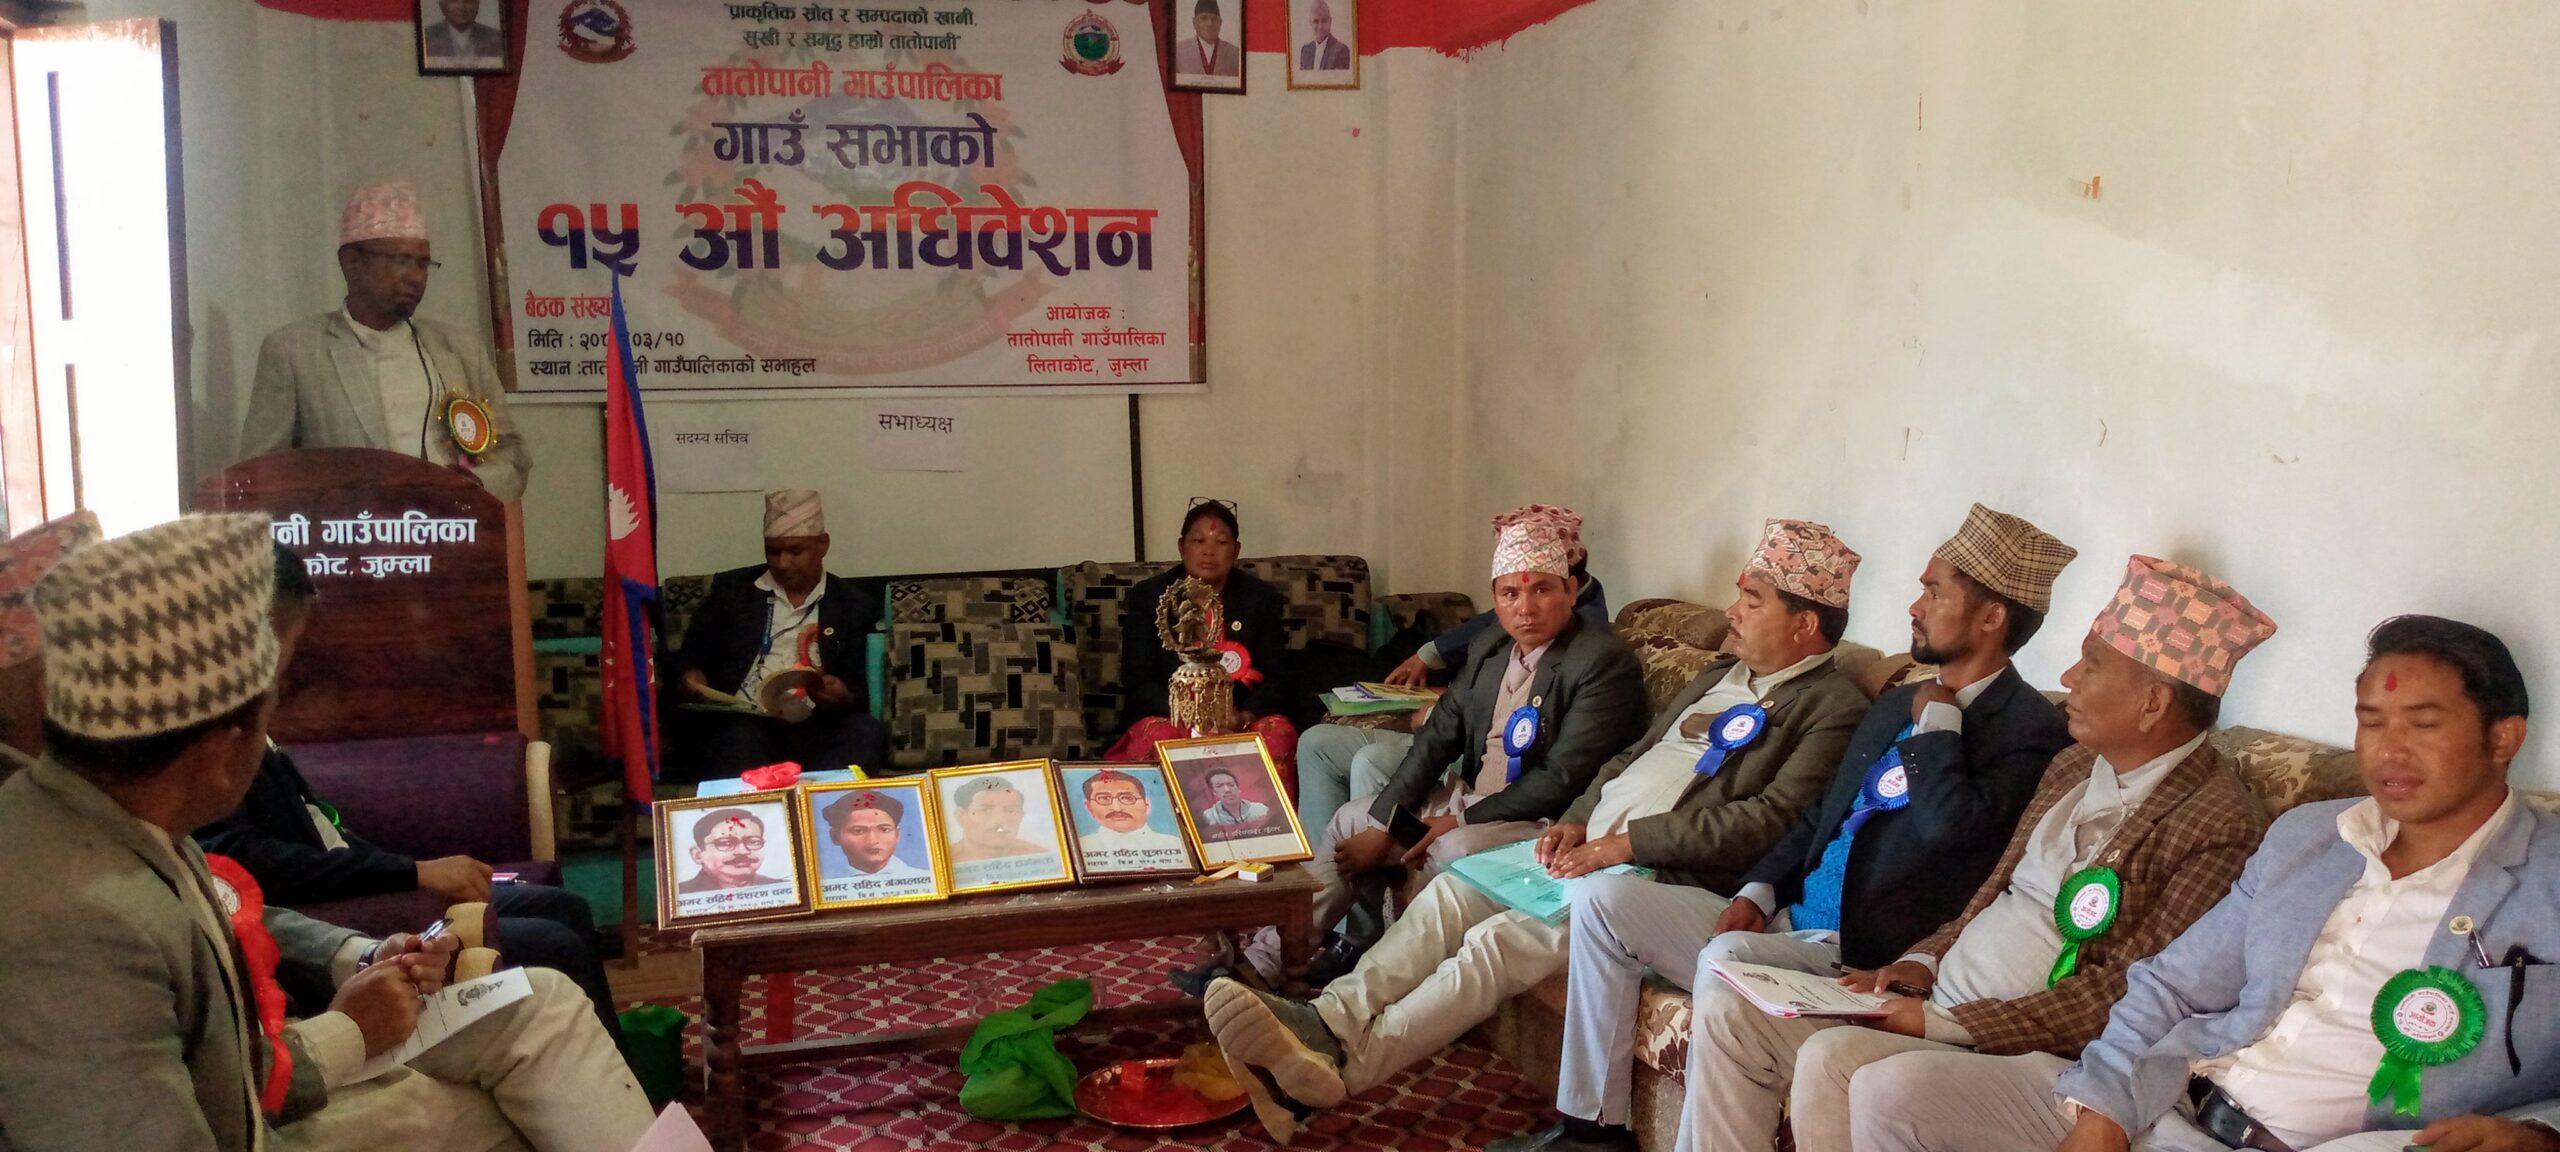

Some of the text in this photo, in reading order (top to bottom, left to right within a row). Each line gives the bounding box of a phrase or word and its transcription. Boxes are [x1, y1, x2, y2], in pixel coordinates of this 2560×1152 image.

[803, 4, 833, 22] स्रोत
[840, 8, 850, 22] र
[856, 6, 929, 25] सम्पदाको
[743, 27, 780, 49] सुखी
[786, 31, 797, 47] र
[848, 30, 884, 49] हाम्रो
[701, 58, 1003, 101] तातोपानी गाउँपालिका
[712, 108, 998, 169] गाउँ सभाको
[537, 178, 1158, 277] १५ औं अधिवेशन
[525, 289, 565, 318] बैठक
[571, 292, 613, 319] संख्य
[1047, 303, 1112, 321] आयोजक
[528, 328, 564, 349] मिति
[1007, 328, 1074, 347] तातोपानी
[1081, 326, 1167, 347] गाउँपालिका
[530, 359, 571, 377] स्थान
[654, 354, 755, 376] गाउँपालिकाको
[760, 357, 817, 377] सभाहल
[1027, 354, 1149, 378] लिताकोट, जुम्ला
[878, 413, 954, 434] सभाध्यक्ष
[675, 428, 749, 446] सदस्य सचिव
[321, 510, 478, 545] गाउँपालिका
[360, 554, 433, 579] जुम्ला
[822, 883, 848, 893] अमर
[852, 879, 882, 890] सहिद
[676, 897, 704, 907] अमर
